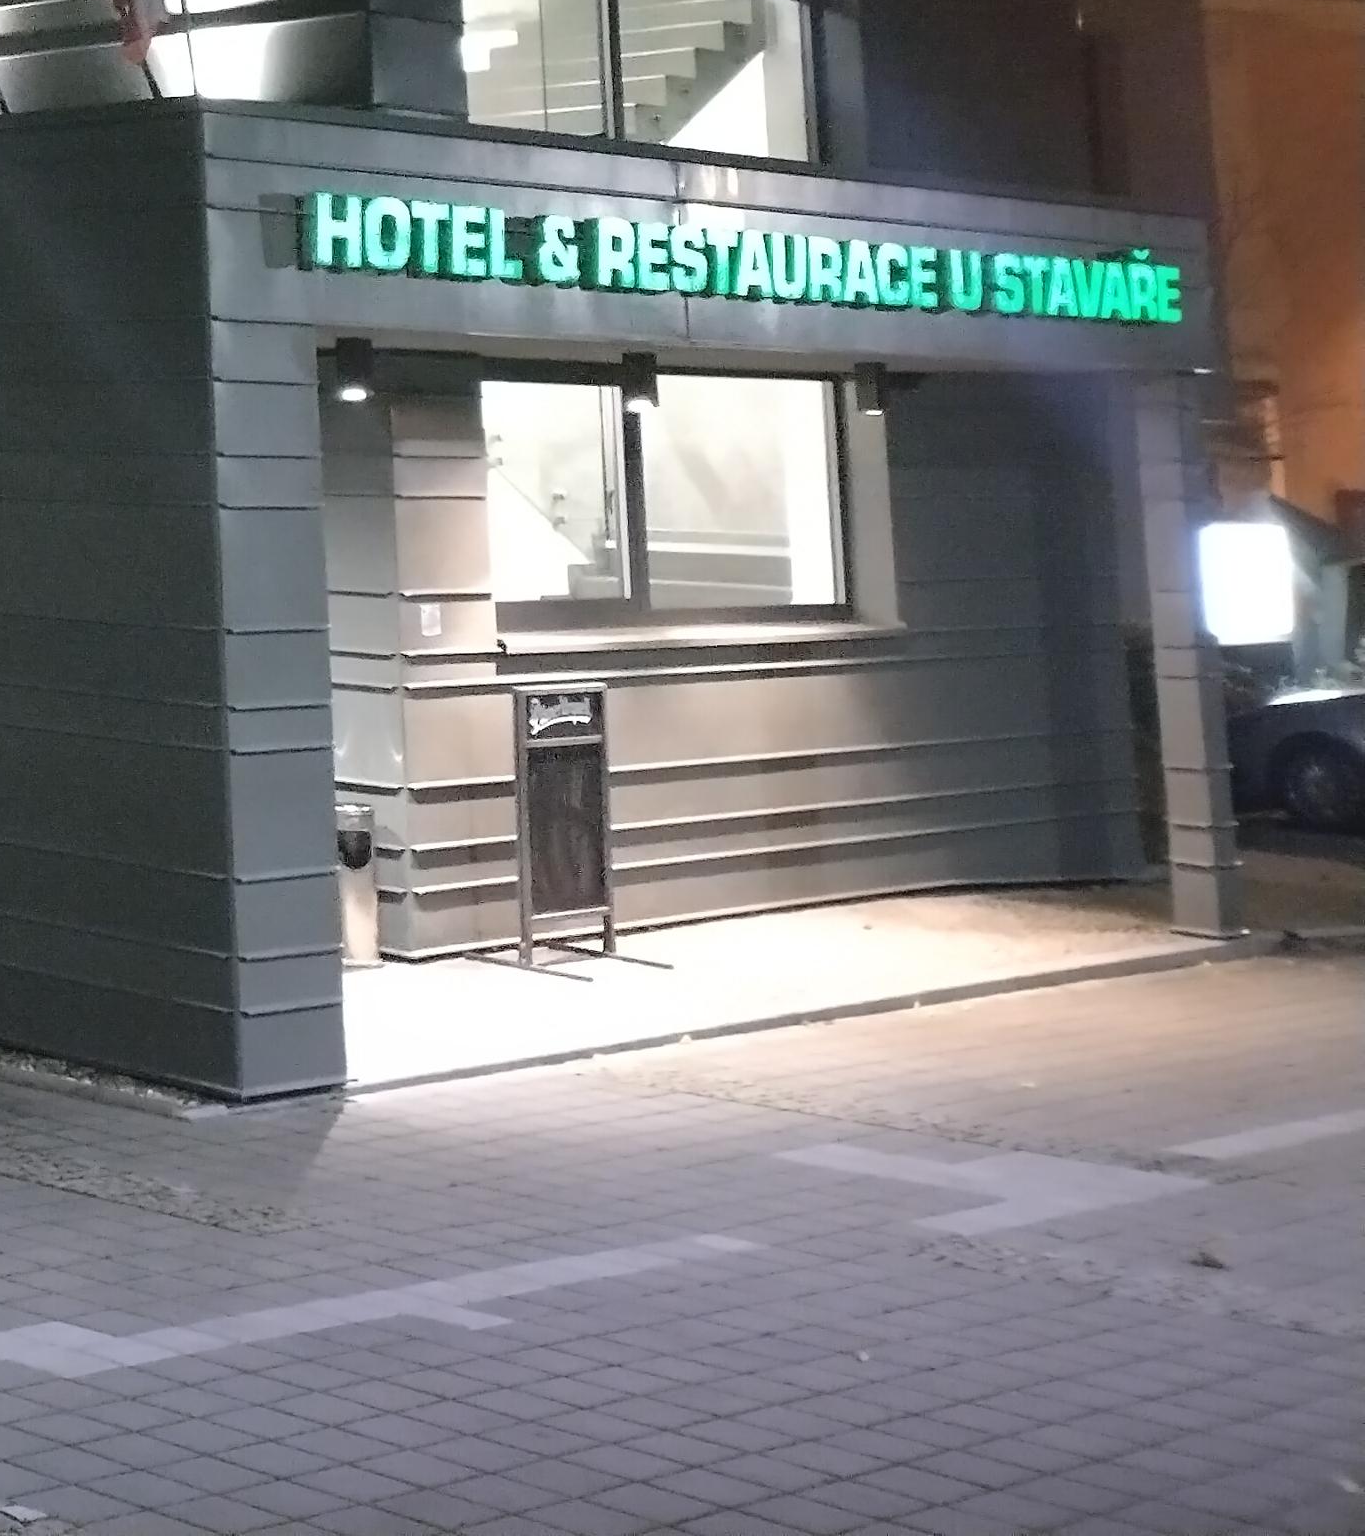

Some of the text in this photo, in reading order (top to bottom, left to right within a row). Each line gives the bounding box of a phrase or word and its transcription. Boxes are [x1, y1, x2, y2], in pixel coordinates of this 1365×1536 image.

[314, 192, 1183, 323] HOTEL & RESTAURACE U STAVAŘE
